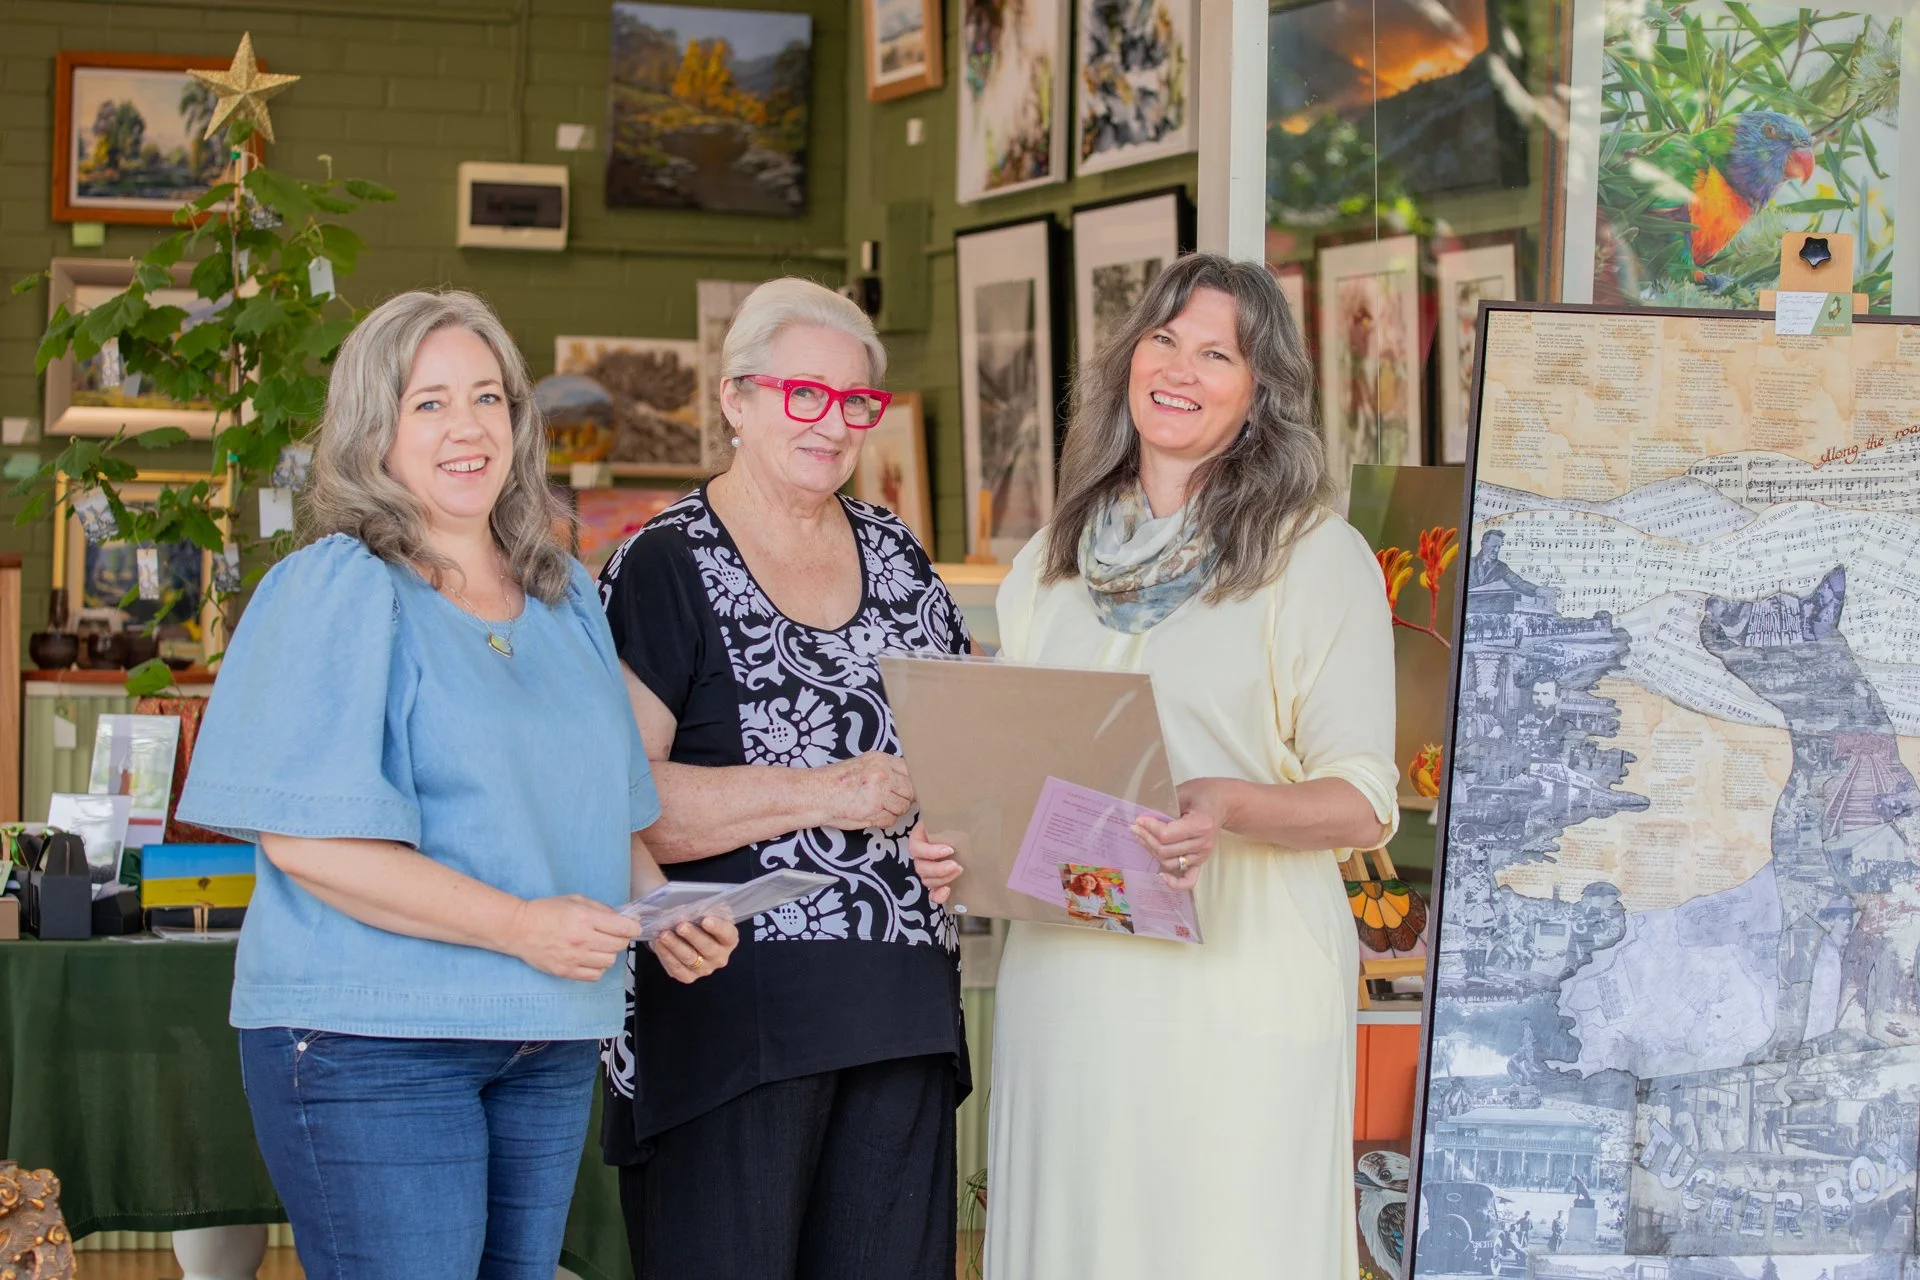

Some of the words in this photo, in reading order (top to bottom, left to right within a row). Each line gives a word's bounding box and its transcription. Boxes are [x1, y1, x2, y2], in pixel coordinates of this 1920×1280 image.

[1813, 444, 1859, 470] Along
[1865, 434, 1885, 450] the
[1894, 424, 1920, 440] roa
[1709, 543, 1723, 555] THE
[1724, 531, 1745, 547] SNAKE
[1746, 519, 1767, 535] GULLY
[1768, 503, 1800, 524] SWAGGER
[1630, 659, 1643, 671] THE
[1643, 668, 1657, 679] OLD
[1656, 677, 1685, 697] BULLOCK
[1638, 1119, 1804, 1238] TUCKER
[1814, 1132, 1915, 1231] BOX
